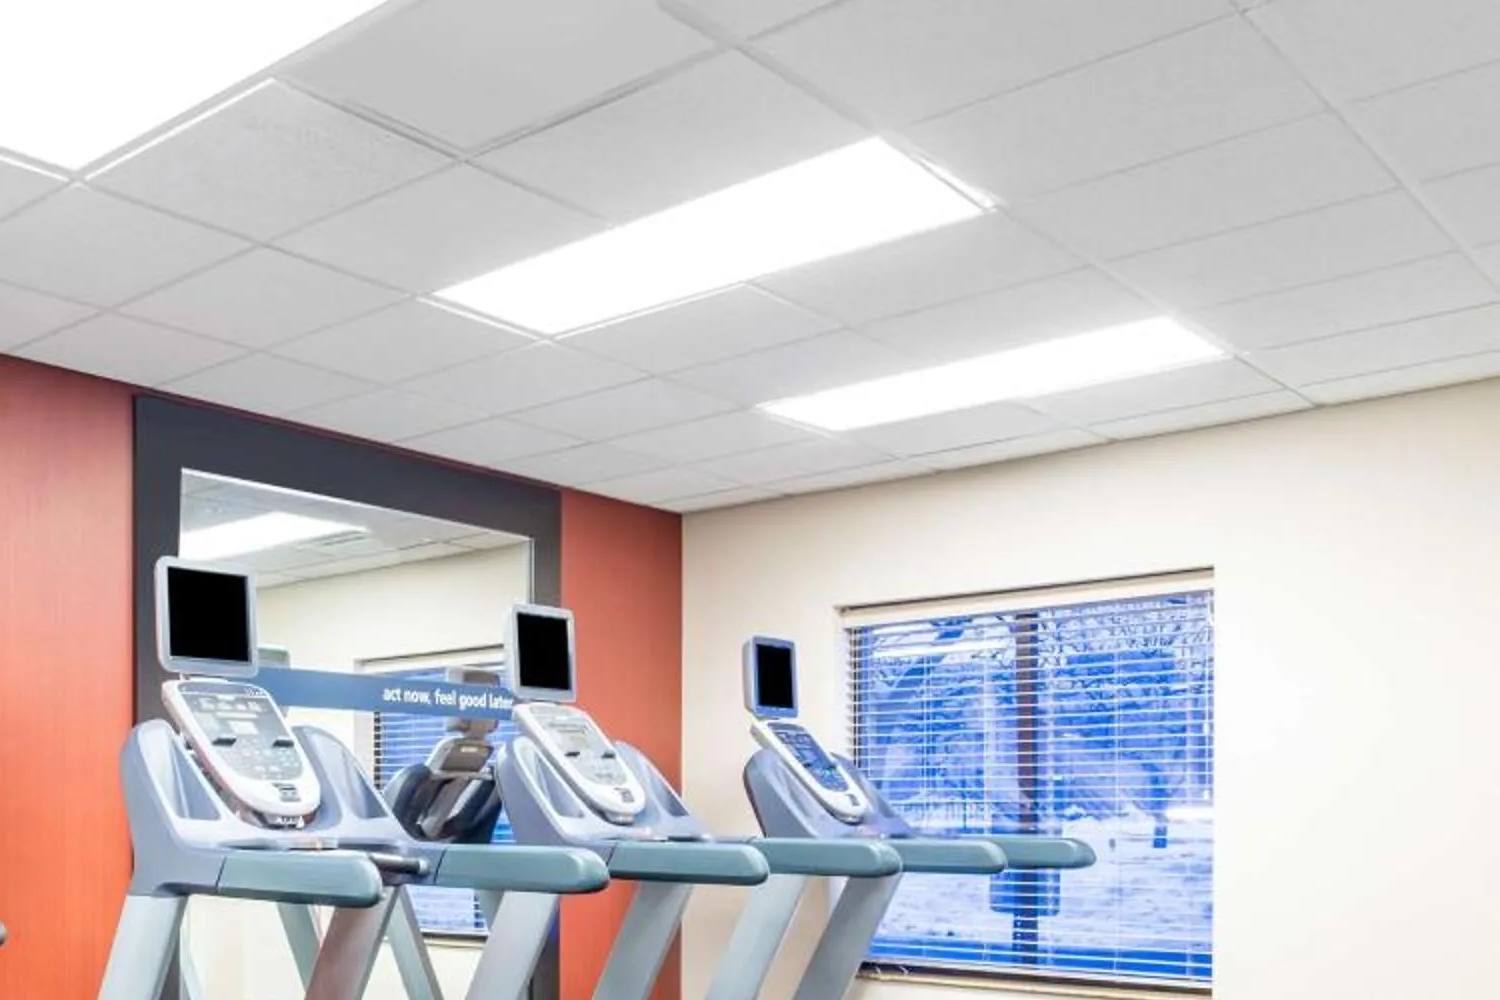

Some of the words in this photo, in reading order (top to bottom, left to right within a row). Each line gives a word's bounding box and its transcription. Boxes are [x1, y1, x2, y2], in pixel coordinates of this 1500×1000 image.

[383, 688, 401, 702] act
[403, 689, 431, 705] now,
[435, 687, 457, 705] feel
[459, 691, 487, 711] good
